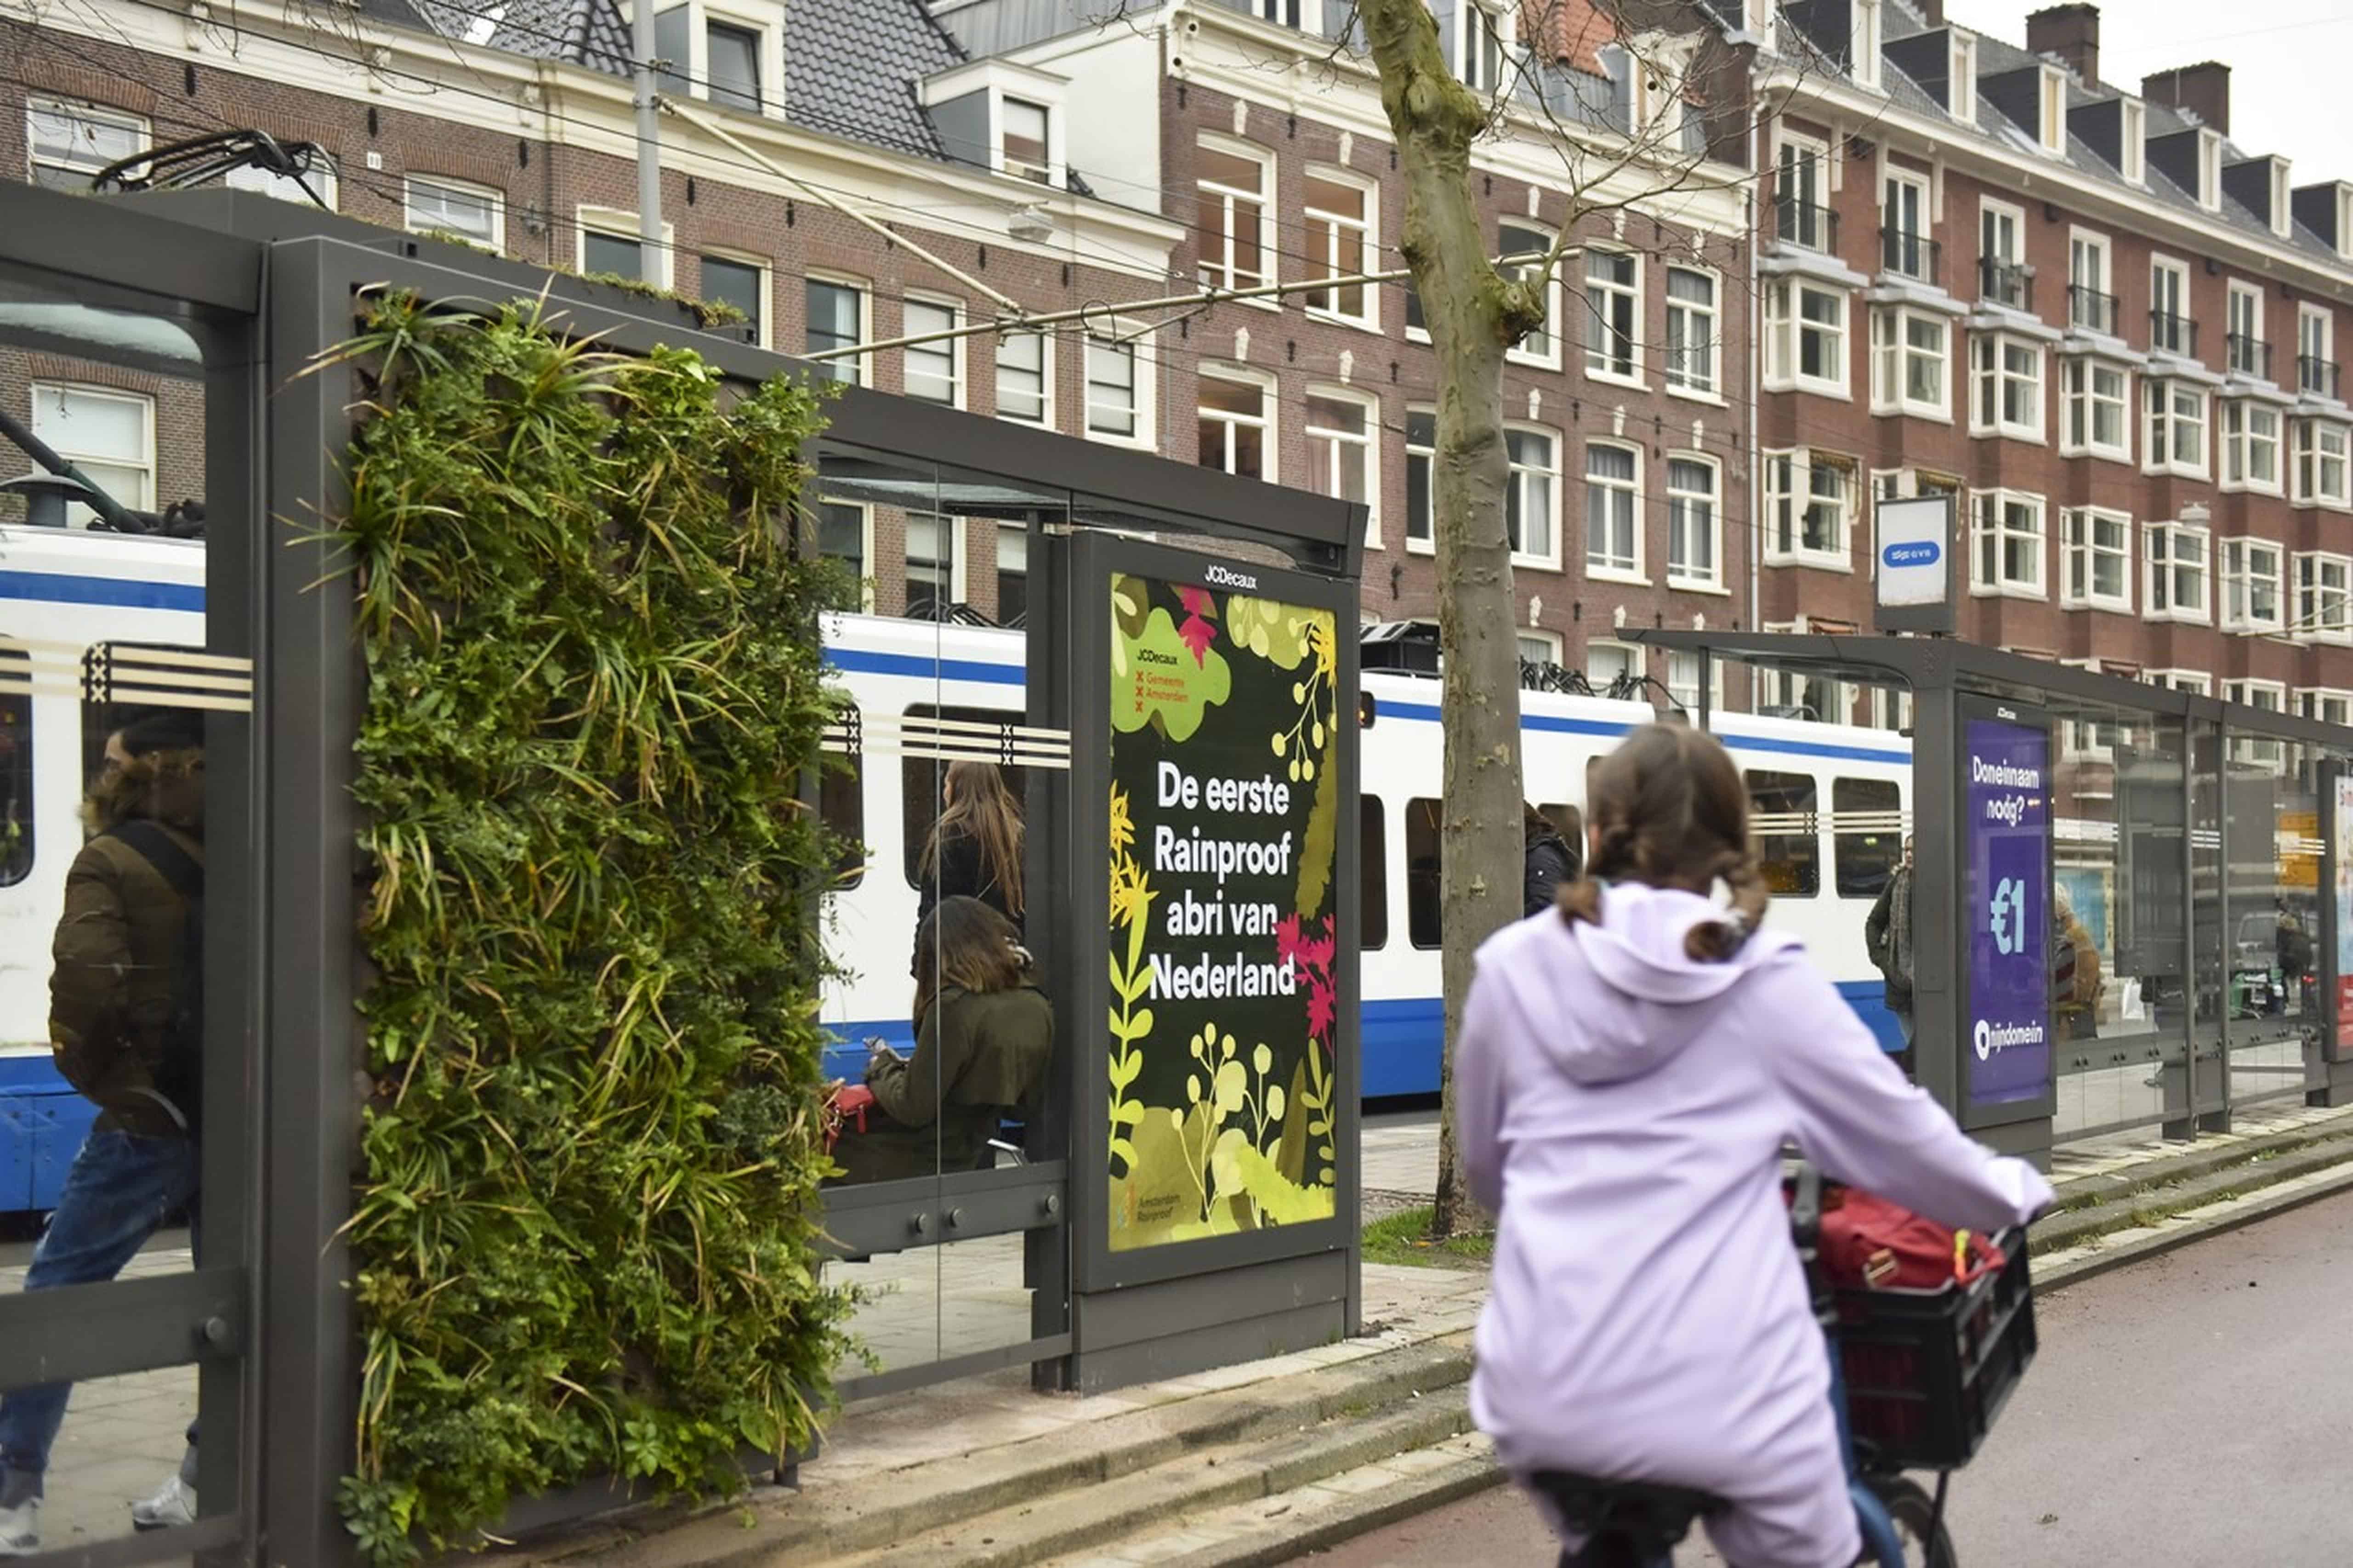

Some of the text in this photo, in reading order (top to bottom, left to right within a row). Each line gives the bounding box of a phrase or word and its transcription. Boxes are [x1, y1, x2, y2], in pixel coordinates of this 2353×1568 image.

[1205, 565, 1257, 590] JCDecaux
[1158, 761, 1290, 815] De eerste
[1155, 825, 1292, 884] Rainproof
[1167, 889, 1278, 936] abri van
[1990, 877, 2024, 954] €1
[1149, 952, 1296, 1000] Nederland
